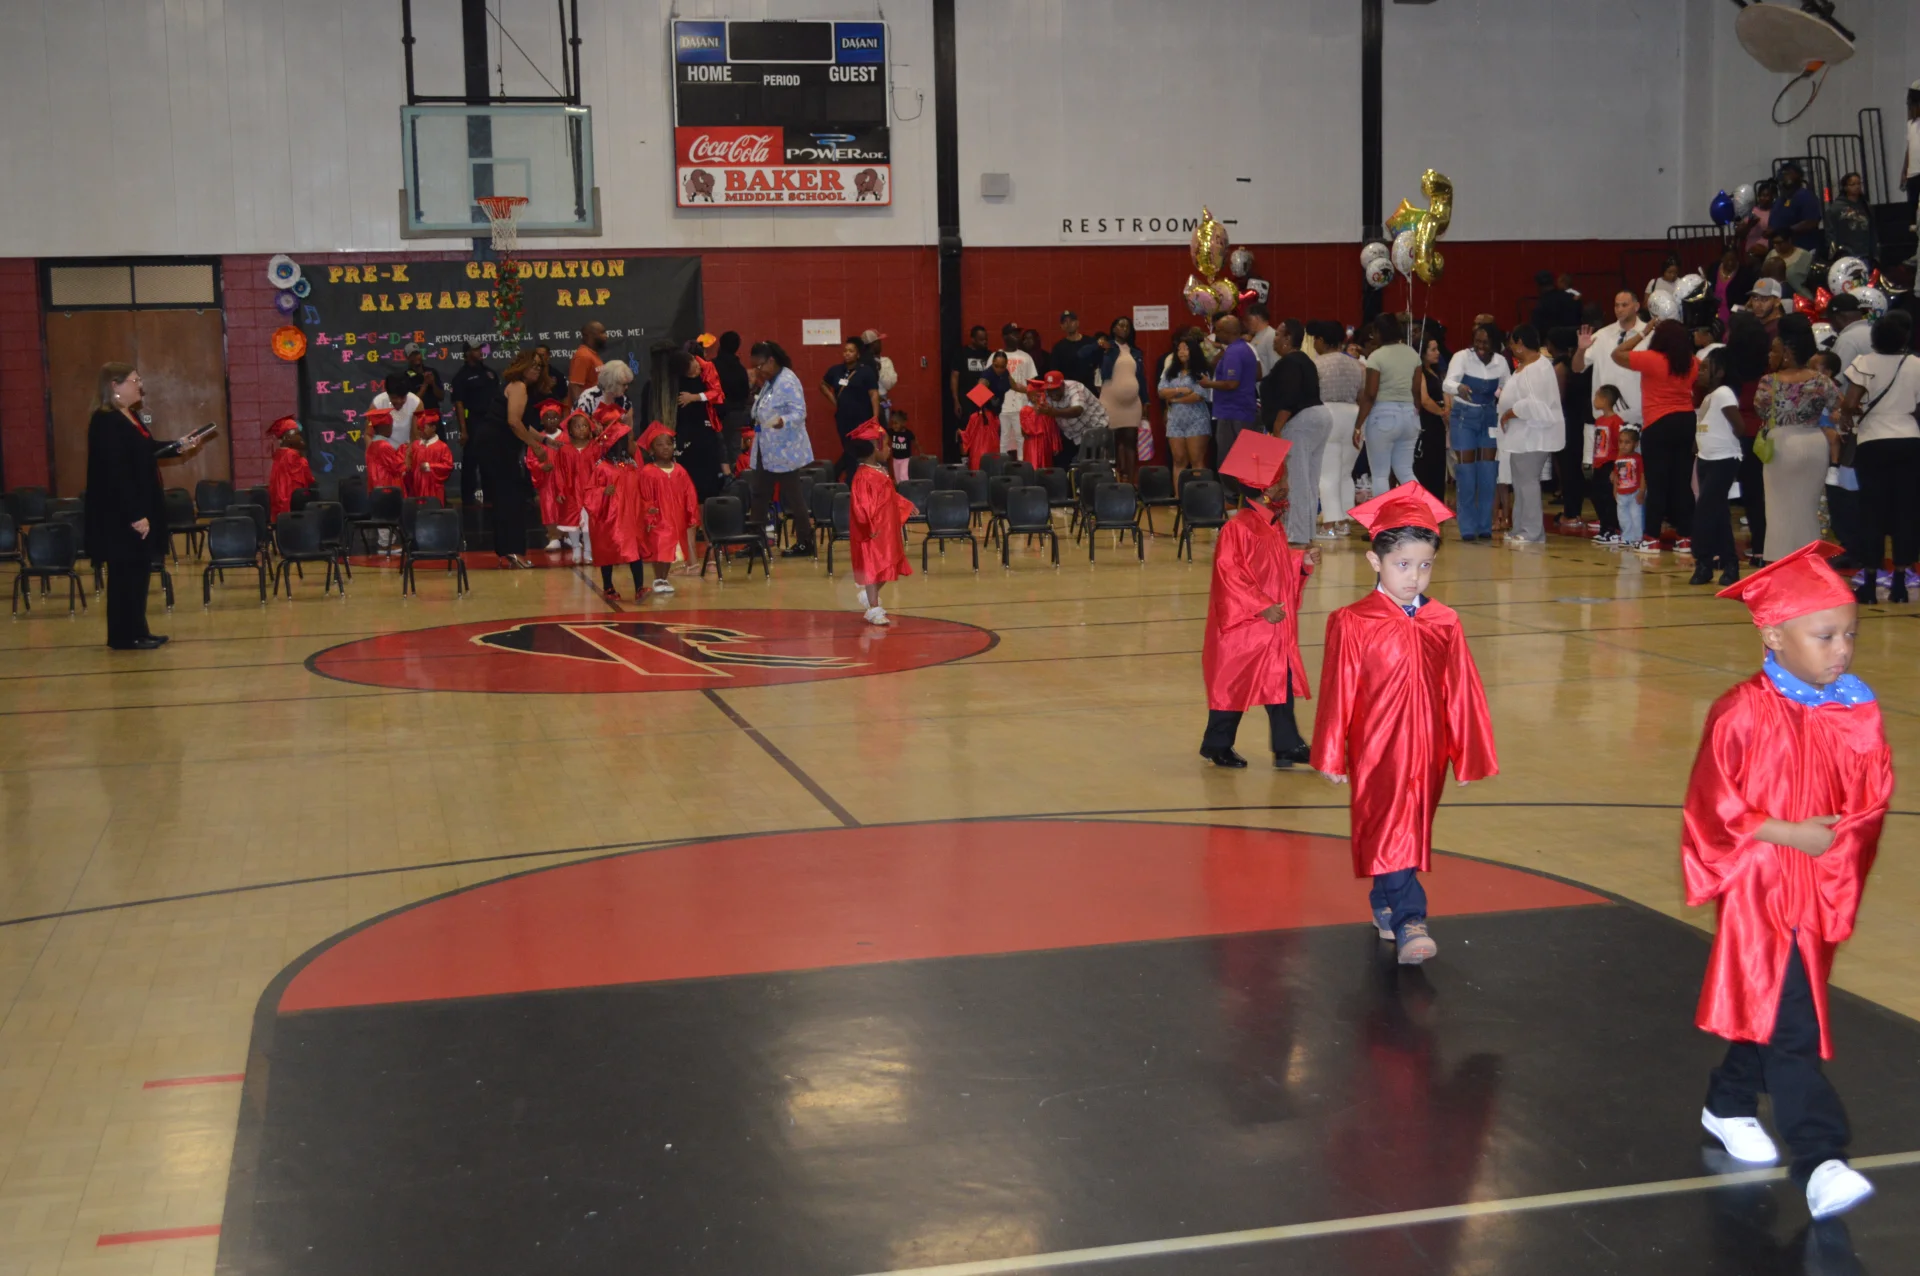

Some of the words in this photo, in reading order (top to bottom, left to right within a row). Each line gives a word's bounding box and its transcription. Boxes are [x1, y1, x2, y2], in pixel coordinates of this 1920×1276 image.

[681, 36, 719, 49] DASANI
[841, 37, 878, 49] DASANI
[687, 66, 732, 81] HOME
[763, 74, 801, 86] PERIOD
[829, 67, 878, 82] GUEST
[688, 134, 774, 163] Coca-Cola
[724, 169, 844, 191] BAKER
[724, 192, 784, 202] MIDDLE
[788, 192, 847, 202] SCHOOL
[328, 264, 410, 284] PRE-K
[465, 259, 625, 280] GRDUATION
[556, 288, 611, 308] RAP
[513, 332, 534, 341] WLL
[538, 331, 551, 341] BE
[554, 330, 571, 340] THE
[605, 329, 624, 338] FOR
